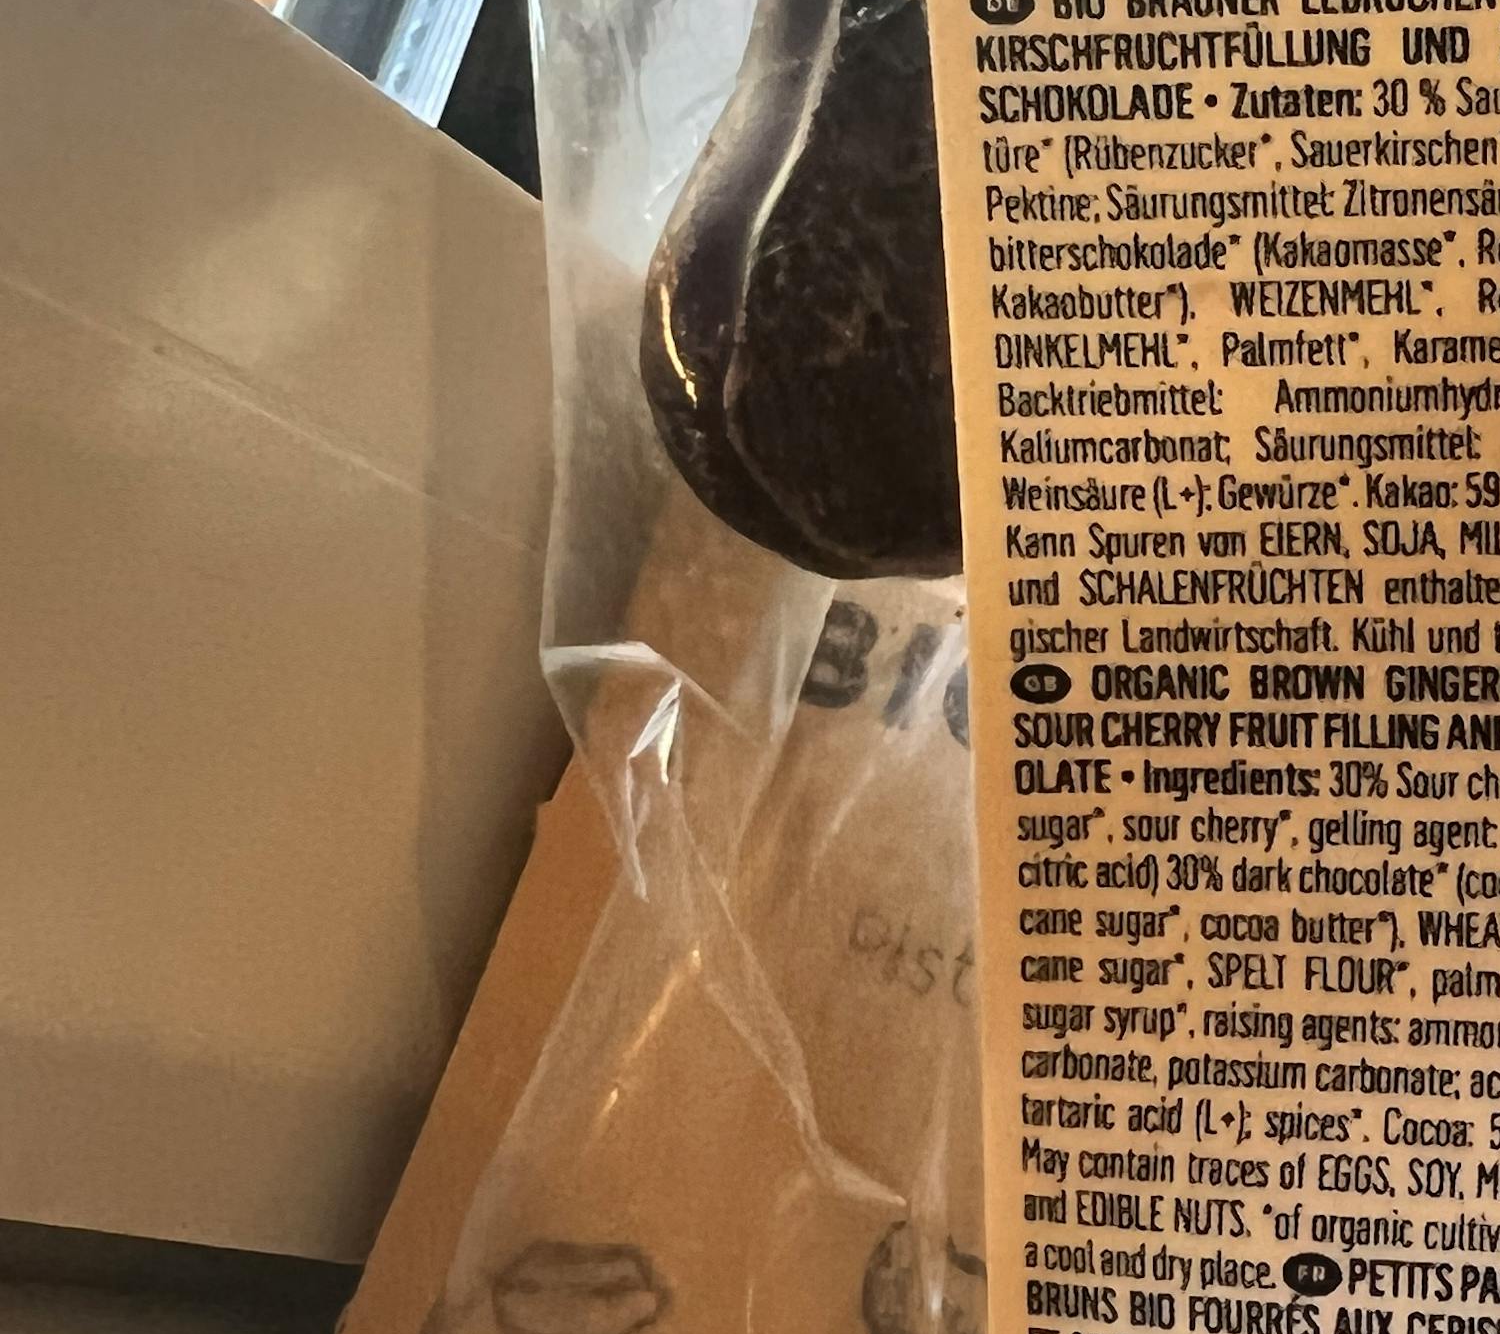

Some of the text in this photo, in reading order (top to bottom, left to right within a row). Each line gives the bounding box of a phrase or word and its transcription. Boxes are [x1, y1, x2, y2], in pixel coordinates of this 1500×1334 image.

[975, 20, 1372, 74] KIRSCHFRUCHTFÜLLUNG
[1402, 25, 1471, 66] UND
[977, 81, 1195, 125] SCHOKOLADE
[1372, 77, 1409, 118] 30
[1418, 77, 1447, 118] %
[1006, 524, 1076, 560] Kann
[1088, 521, 1186, 566] Spuren
[1196, 530, 1247, 559] von
[1009, 618, 1110, 664] gischer
[1352, 616, 1416, 654] Kühl
[1427, 618, 1481, 655] und
[1090, 663, 1231, 703] ORGANIC
[1249, 663, 1365, 702] BROWN
[1012, 711, 1095, 750] SOUR
[1100, 710, 1222, 749] CHERRY
[1229, 711, 1320, 750] FRUIT
[1323, 711, 1441, 751] FILLING
[1026, 1279, 1119, 1325] BRUNS
[1129, 1290, 1176, 1331] BIO
